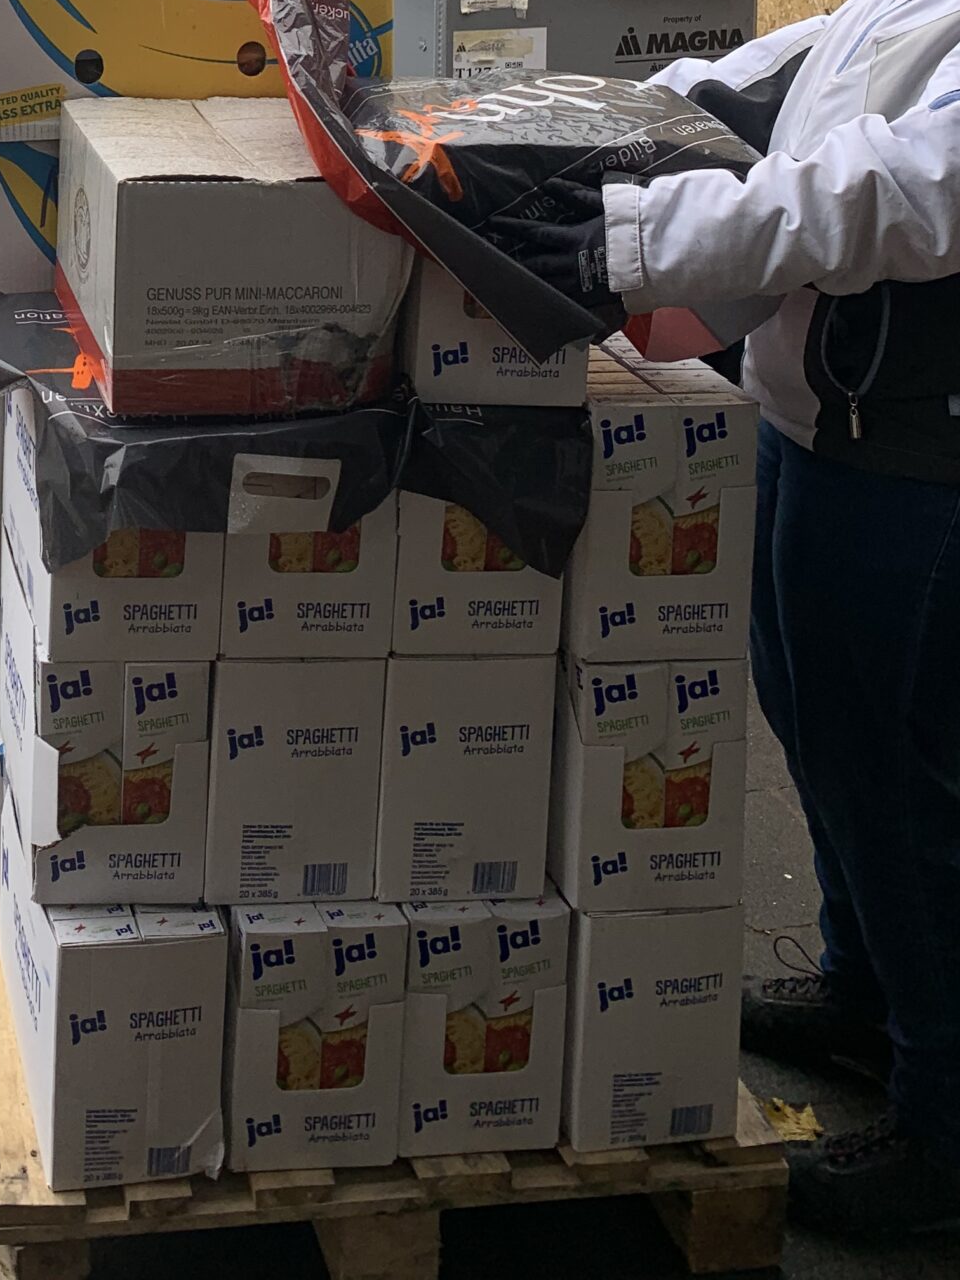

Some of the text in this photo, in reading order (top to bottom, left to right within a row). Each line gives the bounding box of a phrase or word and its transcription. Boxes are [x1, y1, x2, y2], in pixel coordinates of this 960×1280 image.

[663, 15, 702, 24] Property of
[646, 28, 745, 54] MAGNA
[20, 87, 61, 103] QUALITY
[20, 98, 62, 116] EXTRA
[147, 286, 343, 301] GENUSS PUR MINI-MACCARONI
[431, 342, 566, 376] ja! SPAGTI
[496, 366, 560, 378] Arrabbiata
[600, 414, 646, 459] ja!
[683, 412, 728, 457] ja!
[606, 457, 658, 477] SPAGHETTI
[688, 454, 739, 475] SPAGHETTI
[63, 600, 197, 634] ja! SPAGHETTI
[237, 598, 370, 633] ja! SPAGHETTI
[409, 597, 539, 631] ja! SPAGHETTI
[471, 618, 534, 630] Arrabbiata
[599, 603, 729, 638] ja! SPAGHETTI
[128, 623, 191, 634] Arrabbiata
[301, 621, 364, 632] Arrabbiata
[662, 622, 723, 635] Arrabbiata
[47, 670, 93, 713] ja!
[132, 673, 178, 715] ja!
[592, 674, 638, 716] ja!
[675, 670, 720, 713] ja!
[52, 711, 105, 730] SPAGHETTI
[137, 713, 190, 732] SPAGHETTI
[597, 715, 650, 734] SPAGHETTI
[680, 711, 731, 730] SPAGHETTI
[227, 726, 359, 760] ja! SPAGHETTI
[400, 723, 530, 756] ja! SPAGHETTI
[464, 743, 524, 755] Arrabbiata
[291, 745, 353, 758] Arrabbiata
[50, 851, 181, 882] ja! SPAGHETTI
[113, 870, 175, 881] Arrabbiata
[591, 851, 721, 886] ja! SPAGHETTI
[654, 870, 715, 882] Arrabbiata
[417, 925, 461, 968] ja!
[497, 919, 541, 963] ja!
[250, 939, 296, 980] ja!
[332, 933, 378, 976] ja!
[422, 965, 473, 985] SPAGHETTI
[501, 959, 551, 979] SPAGHETTI
[255, 979, 308, 997] SPAGHETTI
[337, 973, 388, 993] SPAGHETTI
[597, 973, 723, 1013] ja! SPAGHETTI
[659, 992, 719, 1008] Arrabbiata
[69, 1006, 202, 1045] ja! SPAGHETTI
[134, 1027, 196, 1042] Arrabbiata
[413, 1097, 540, 1134] ja! SPAGHETTI
[473, 1115, 534, 1128] Arrabbiata
[246, 1113, 376, 1147] ja! SPAGHETTI
[308, 1131, 370, 1144] Arrabbiata
